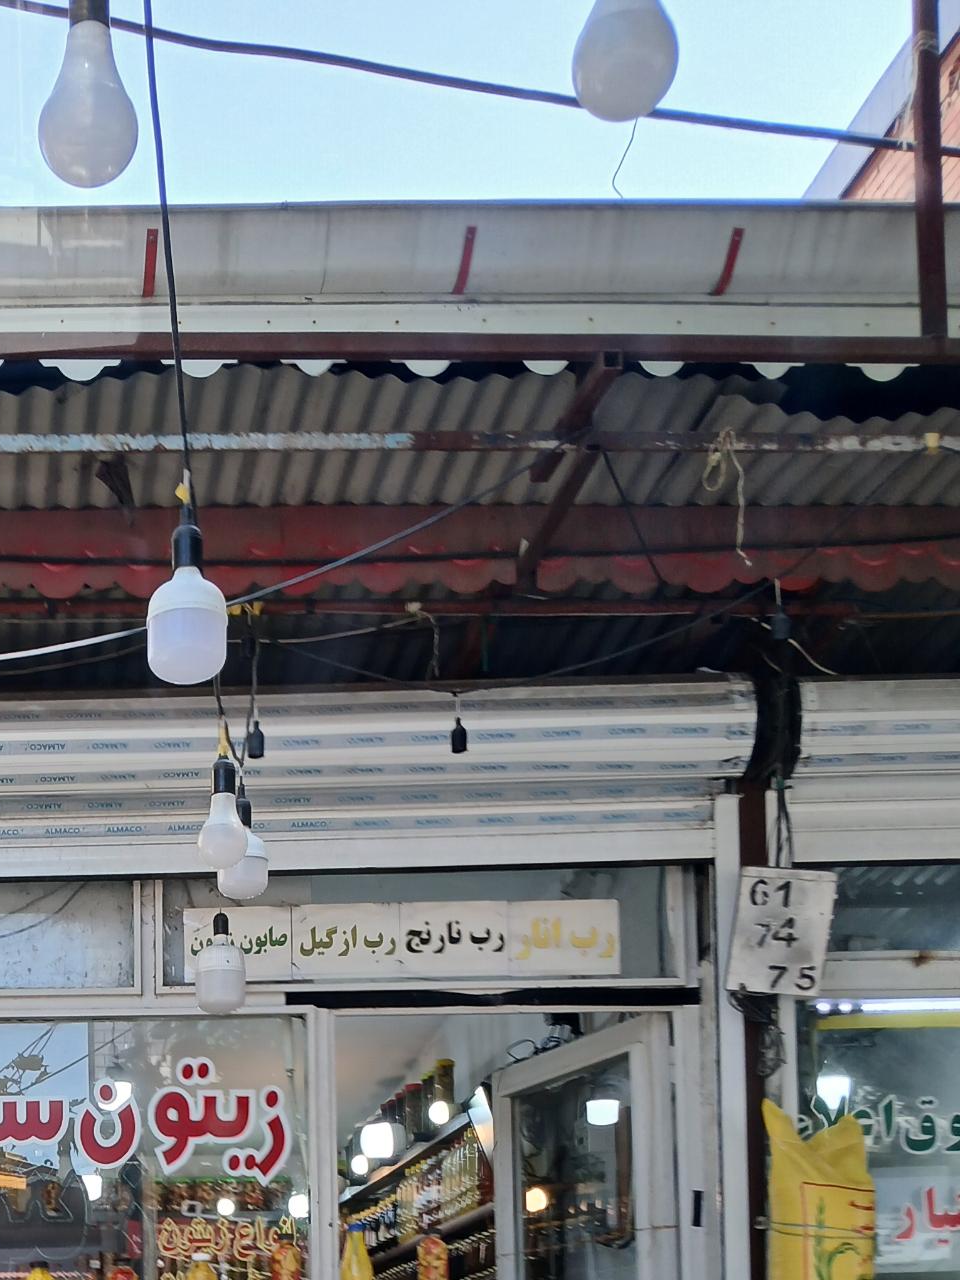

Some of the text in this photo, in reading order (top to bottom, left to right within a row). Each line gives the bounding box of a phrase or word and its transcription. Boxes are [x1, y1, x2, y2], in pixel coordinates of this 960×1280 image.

[29, 743, 66, 751] ALMACO
[40, 775, 76, 783] ALMACO
[163, 771, 200, 779] ALMACO
[26, 802, 62, 810] ALMACO
[87, 800, 123, 809] ALMACO
[148, 799, 185, 807] ALMACO
[44, 827, 80, 835] ALMACO
[106, 825, 142, 833] ALMACO
[168, 824, 203, 832] ALMACO
[291, 821, 327, 829] ALMACO
[749, 878, 793, 908] 61
[240, 925, 288, 955] صابون
[299, 923, 397, 958] رب ازگیل
[405, 920, 505, 954] رب نارنج
[514, 916, 617, 961] رب انار
[755, 916, 800, 949] 74
[768, 965, 817, 991] 75
[82, 1060, 288, 1180] زیتون
